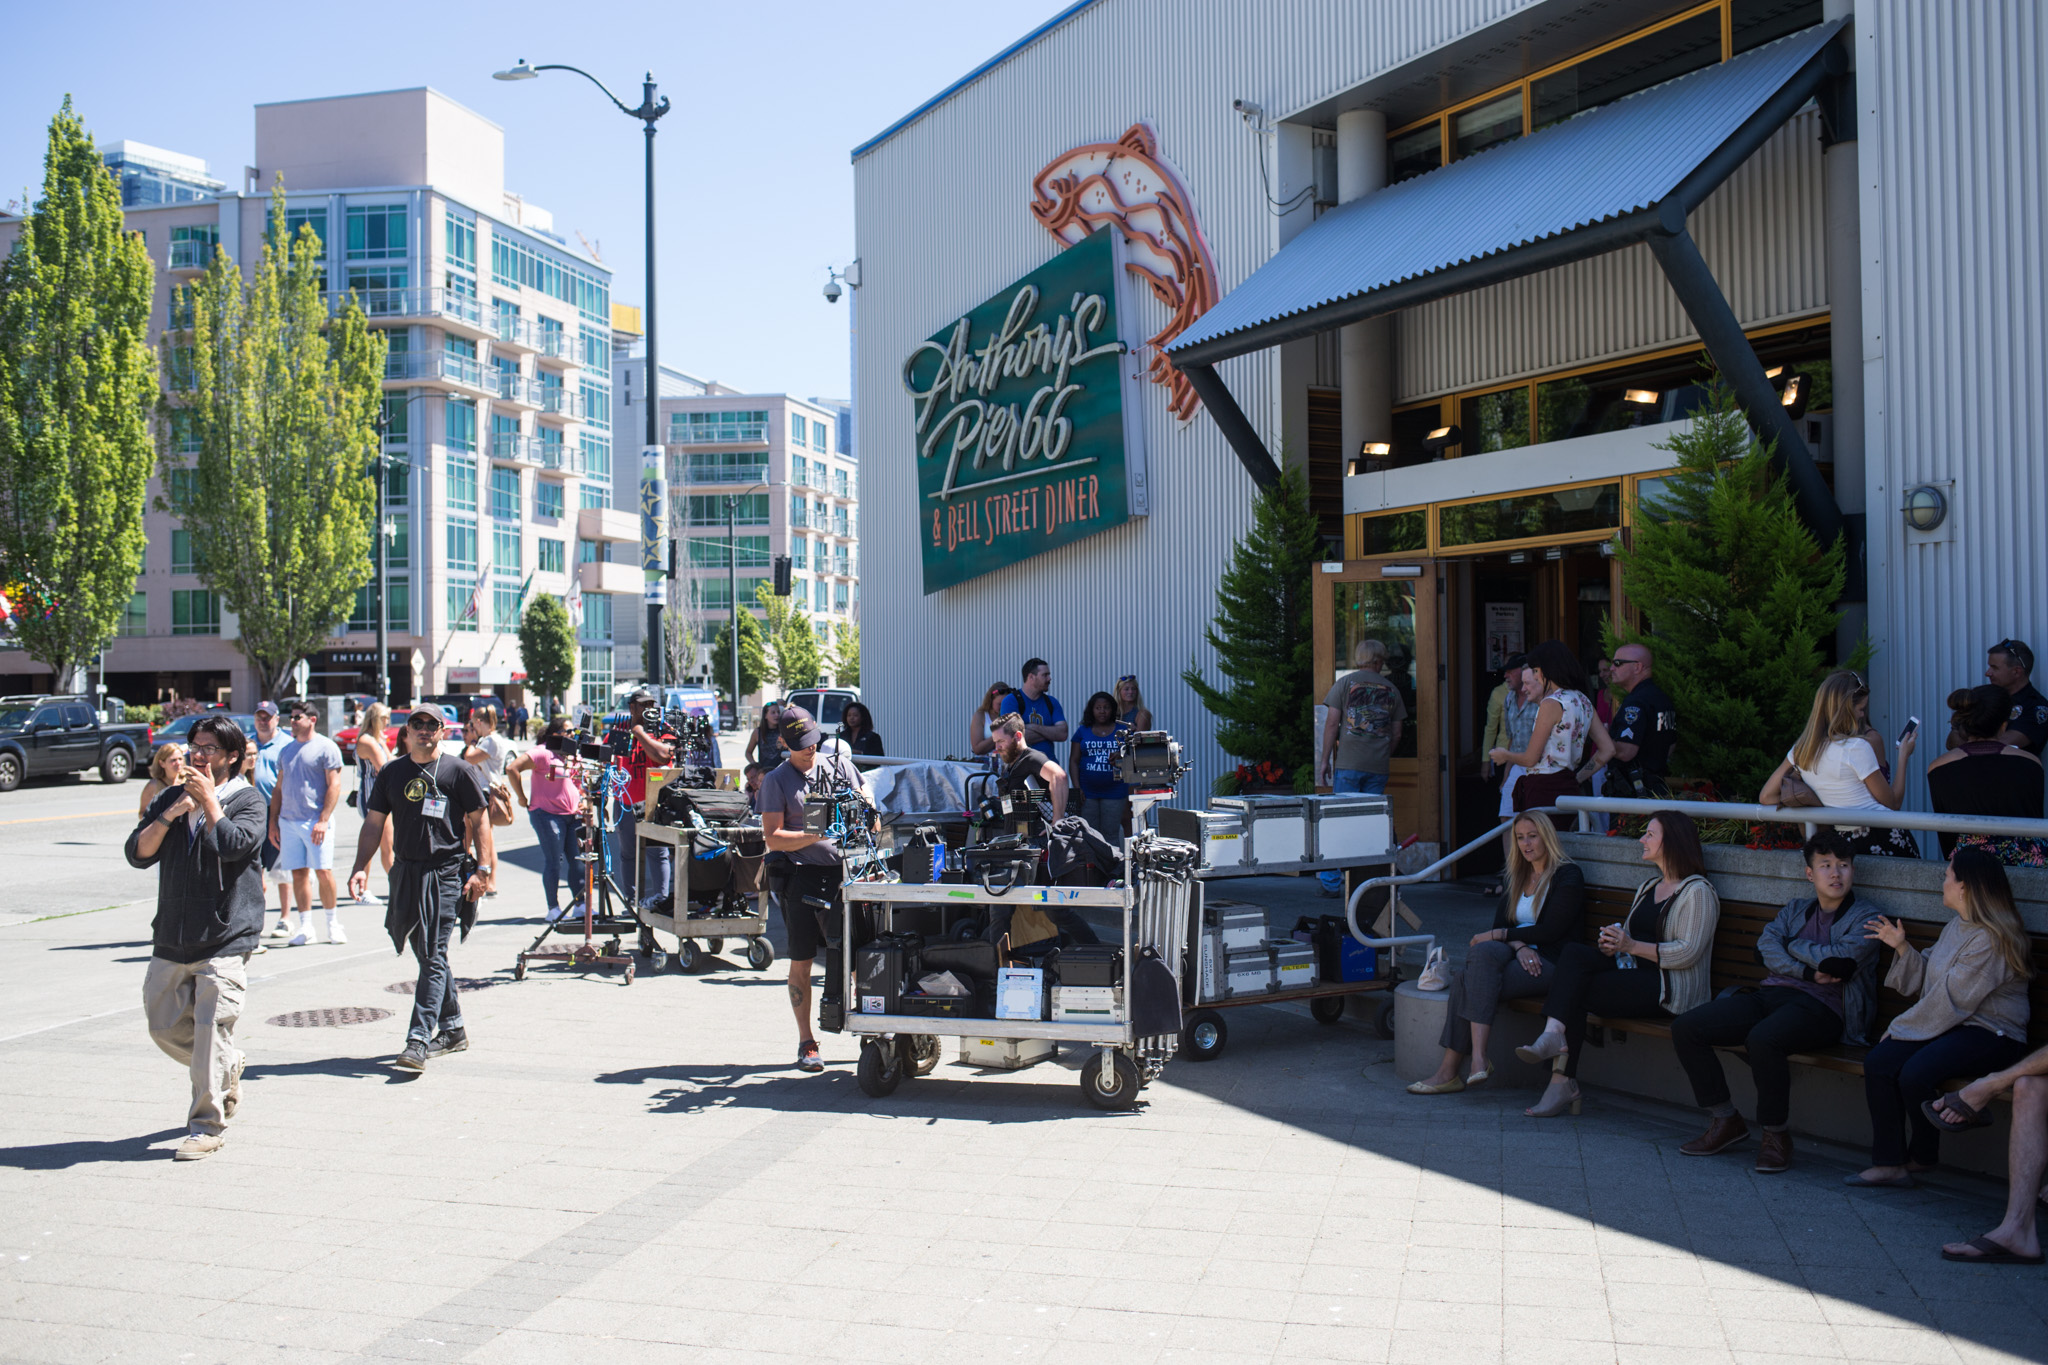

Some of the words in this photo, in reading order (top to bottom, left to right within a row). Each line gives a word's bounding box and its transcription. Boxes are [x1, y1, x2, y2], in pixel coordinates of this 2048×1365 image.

[901, 284, 1128, 435] Anthony's
[933, 508, 941, 547] &
[948, 500, 980, 552] BELL
[984, 487, 1039, 546] STREET
[1046, 474, 1100, 535] DINER
[332, 653, 396, 662] ENTRAE
[1085, 741, 1119, 749] YOU'RE
[1095, 755, 1108, 764] ME
[634, 765, 645, 779] IT
[1086, 763, 1113, 772] SMALL
